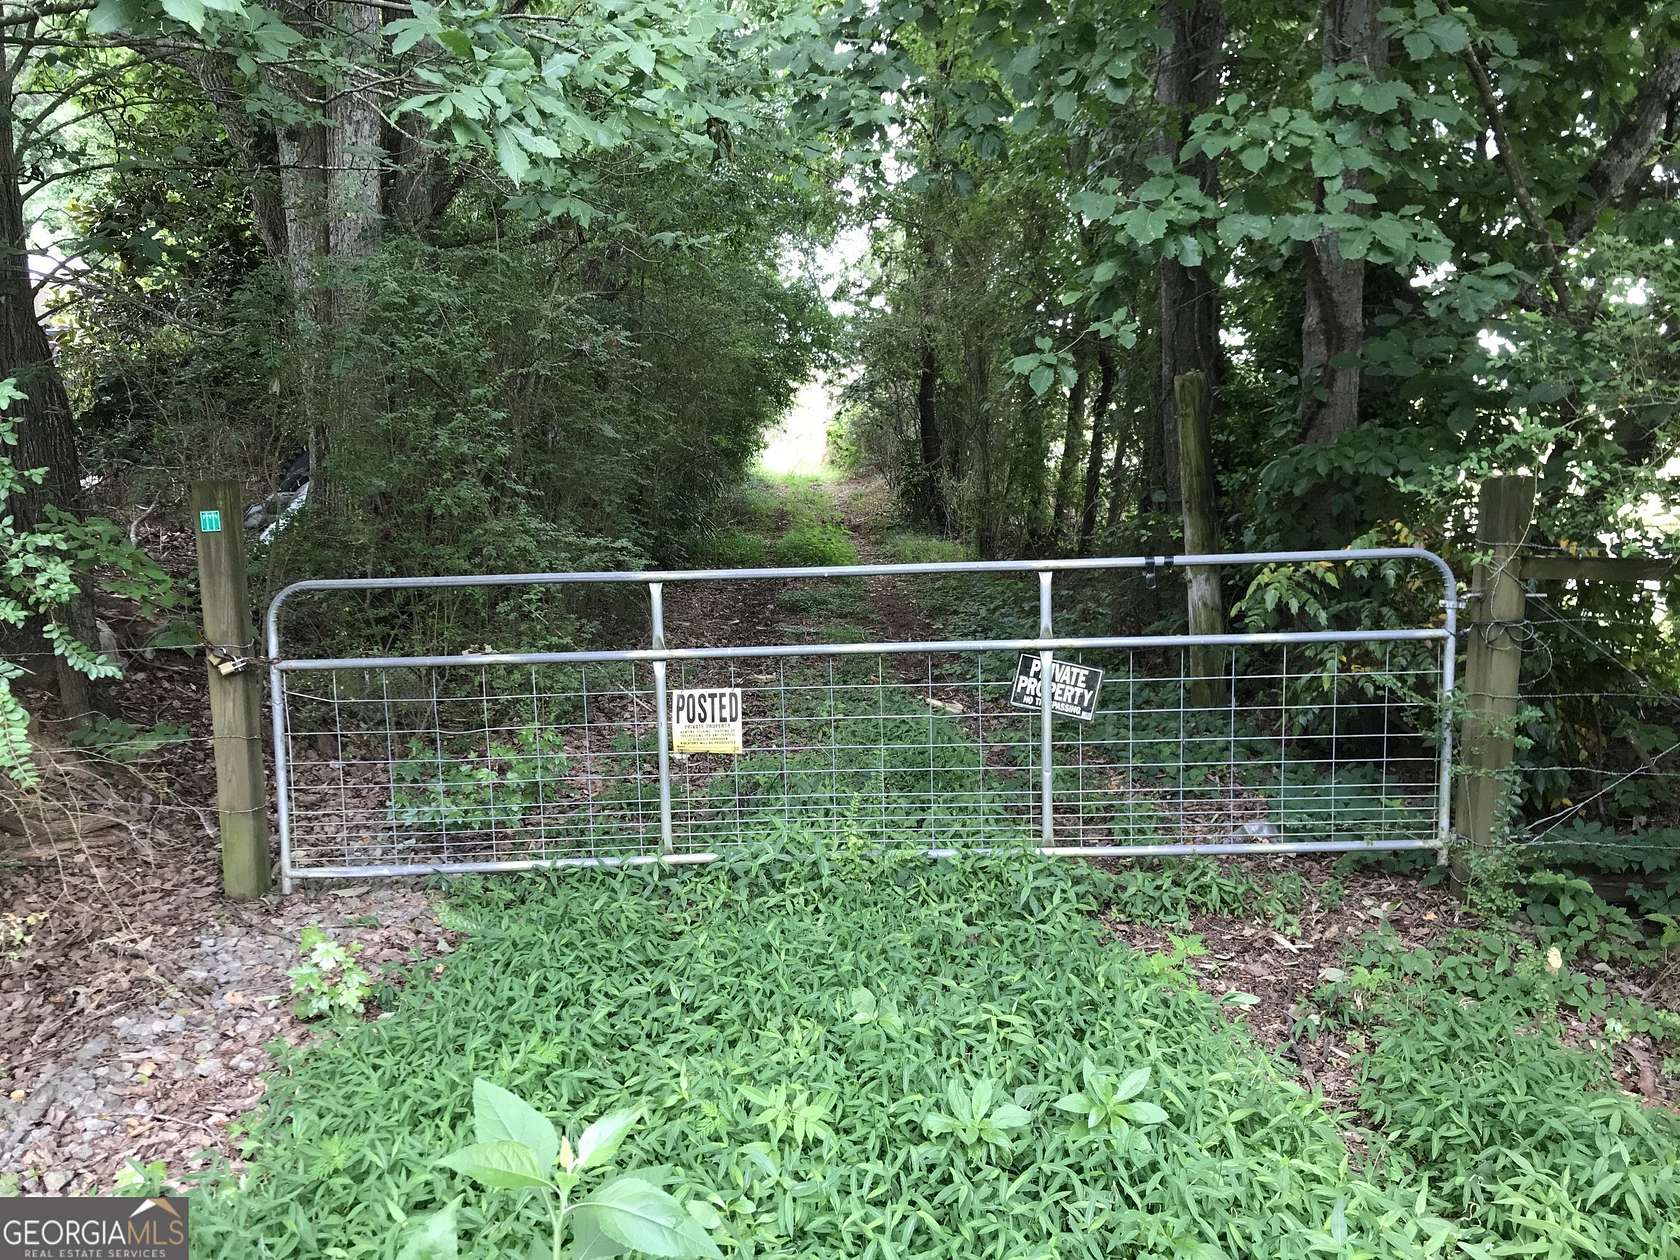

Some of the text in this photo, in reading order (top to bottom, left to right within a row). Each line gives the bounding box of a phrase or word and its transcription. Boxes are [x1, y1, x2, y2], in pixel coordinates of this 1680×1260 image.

[1029, 659, 1089, 688] PIVATE
[676, 692, 739, 724] POSTED
[1022, 695, 1034, 704] NO
